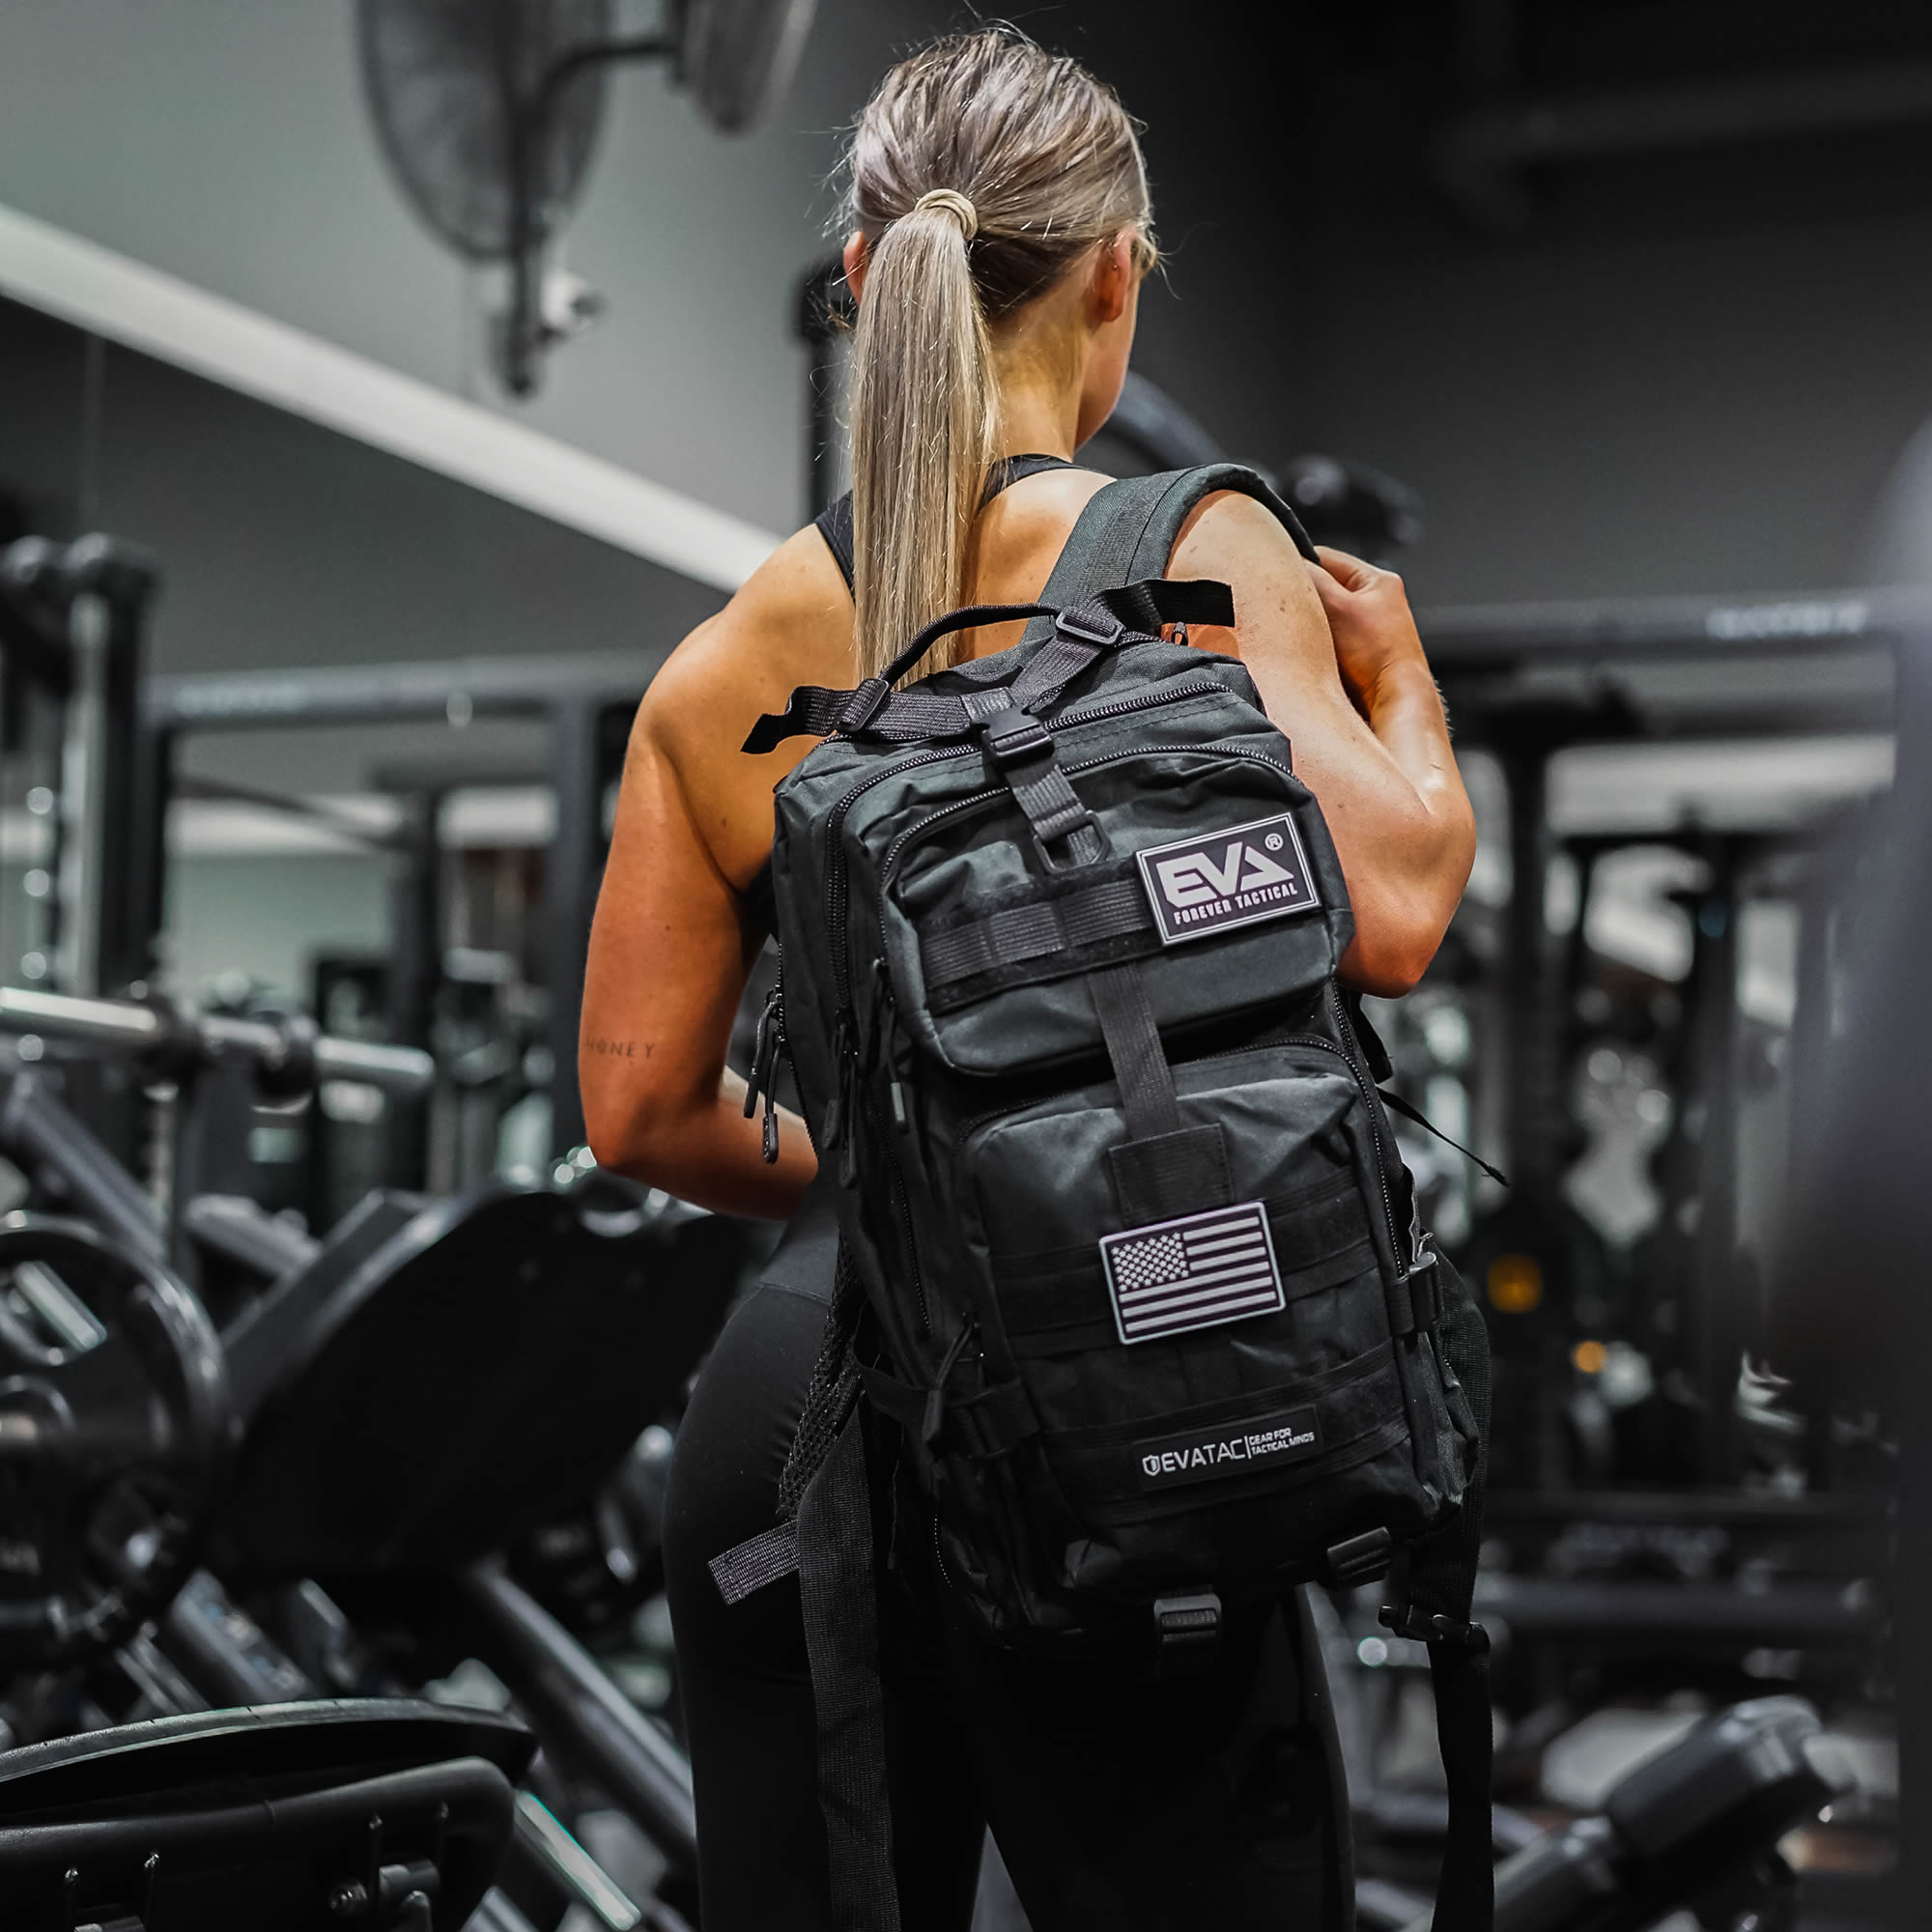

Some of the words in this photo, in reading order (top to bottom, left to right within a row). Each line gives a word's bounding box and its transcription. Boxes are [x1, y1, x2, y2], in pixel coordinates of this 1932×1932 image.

[1156, 841, 1294, 908] EVA
[1174, 900, 1232, 925] FOREVER
[1236, 882, 1298, 909] TACTICAL
[586, 1037, 655, 1059] HONEY
[1249, 1432, 1273, 1446] GEAR
[1273, 1427, 1292, 1439] FOR
[1251, 1439, 1290, 1456] TACTICAL
[1289, 1432, 1315, 1447] MINDS
[1161, 1439, 1246, 1472] EVATAC
